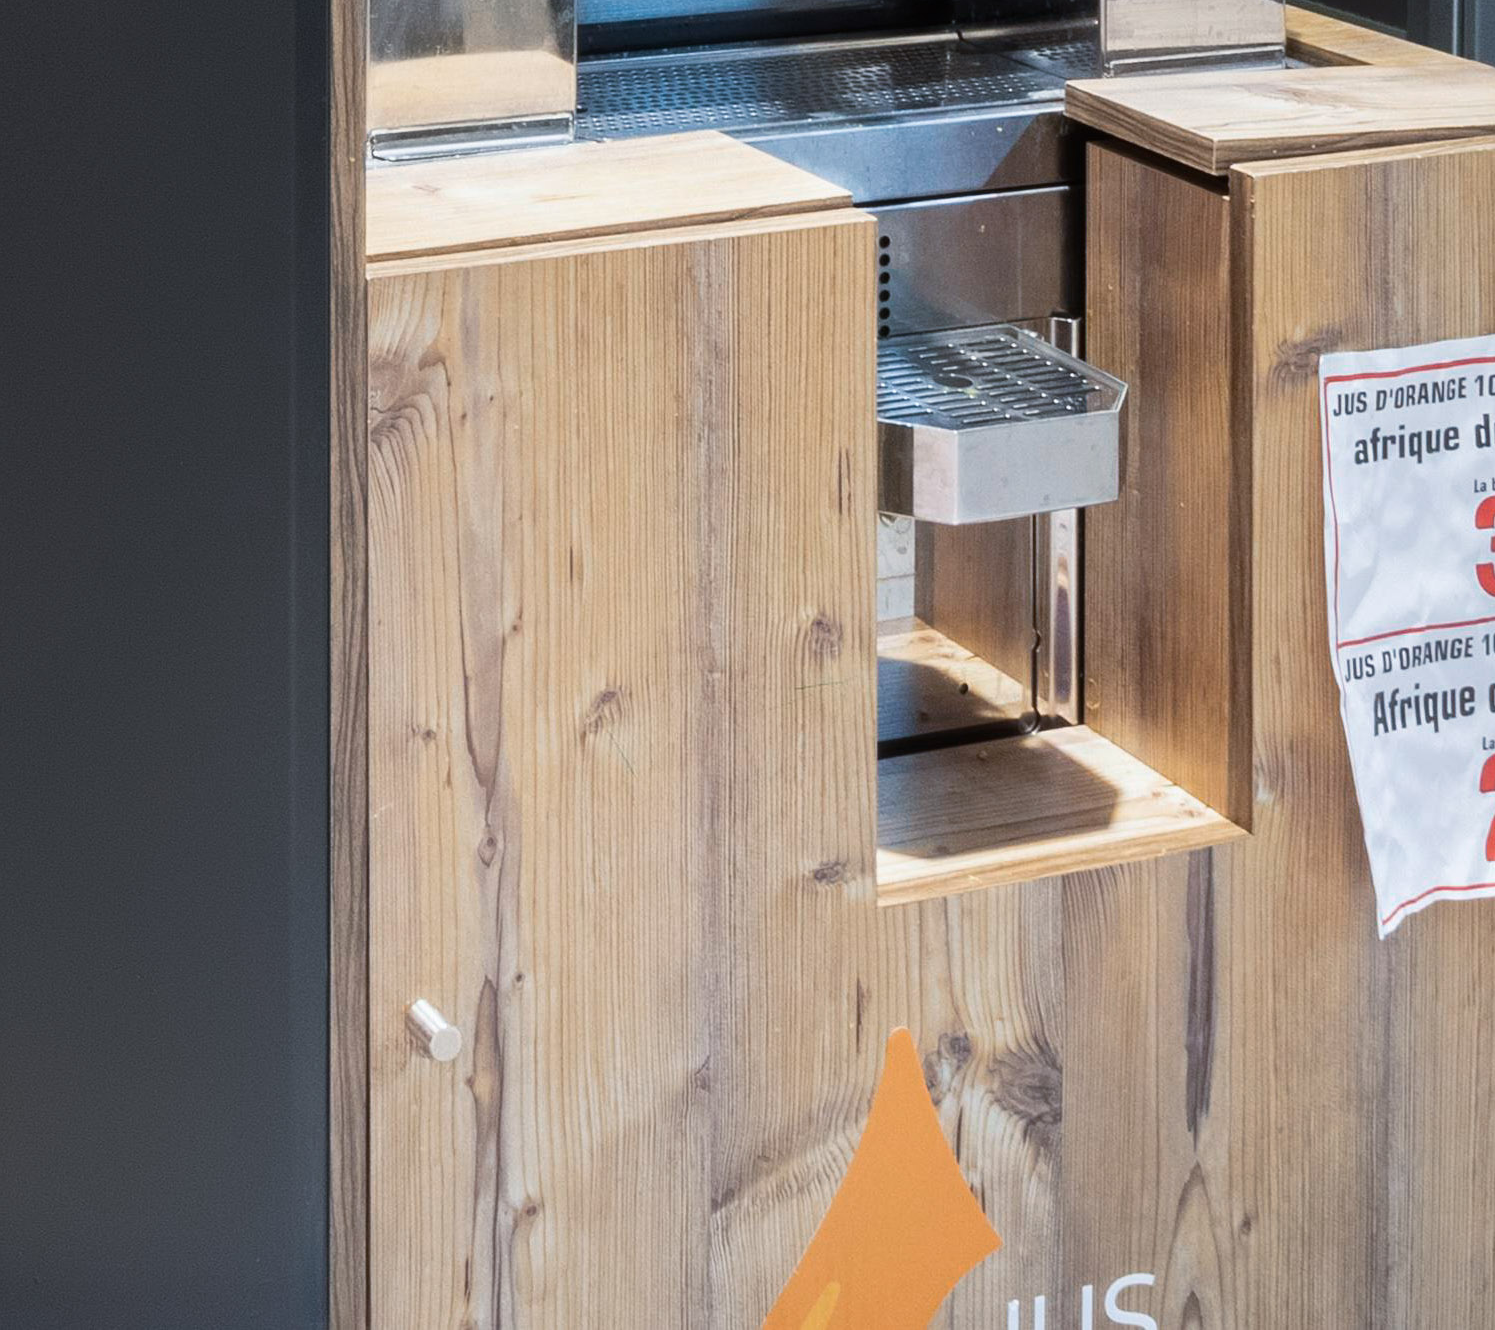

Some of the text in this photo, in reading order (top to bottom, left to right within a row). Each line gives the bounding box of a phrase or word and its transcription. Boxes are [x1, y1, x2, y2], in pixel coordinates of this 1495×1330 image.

[1333, 391, 1368, 416] JUS
[1375, 377, 1467, 411] D'ORANGE
[1354, 424, 1460, 465] afrique
[1474, 479, 1488, 493] La
[1344, 654, 1376, 683] JUS
[1382, 637, 1474, 674] D'ORANGE
[1372, 683, 1475, 737] Afrique
[1482, 736, 1495, 751] La
